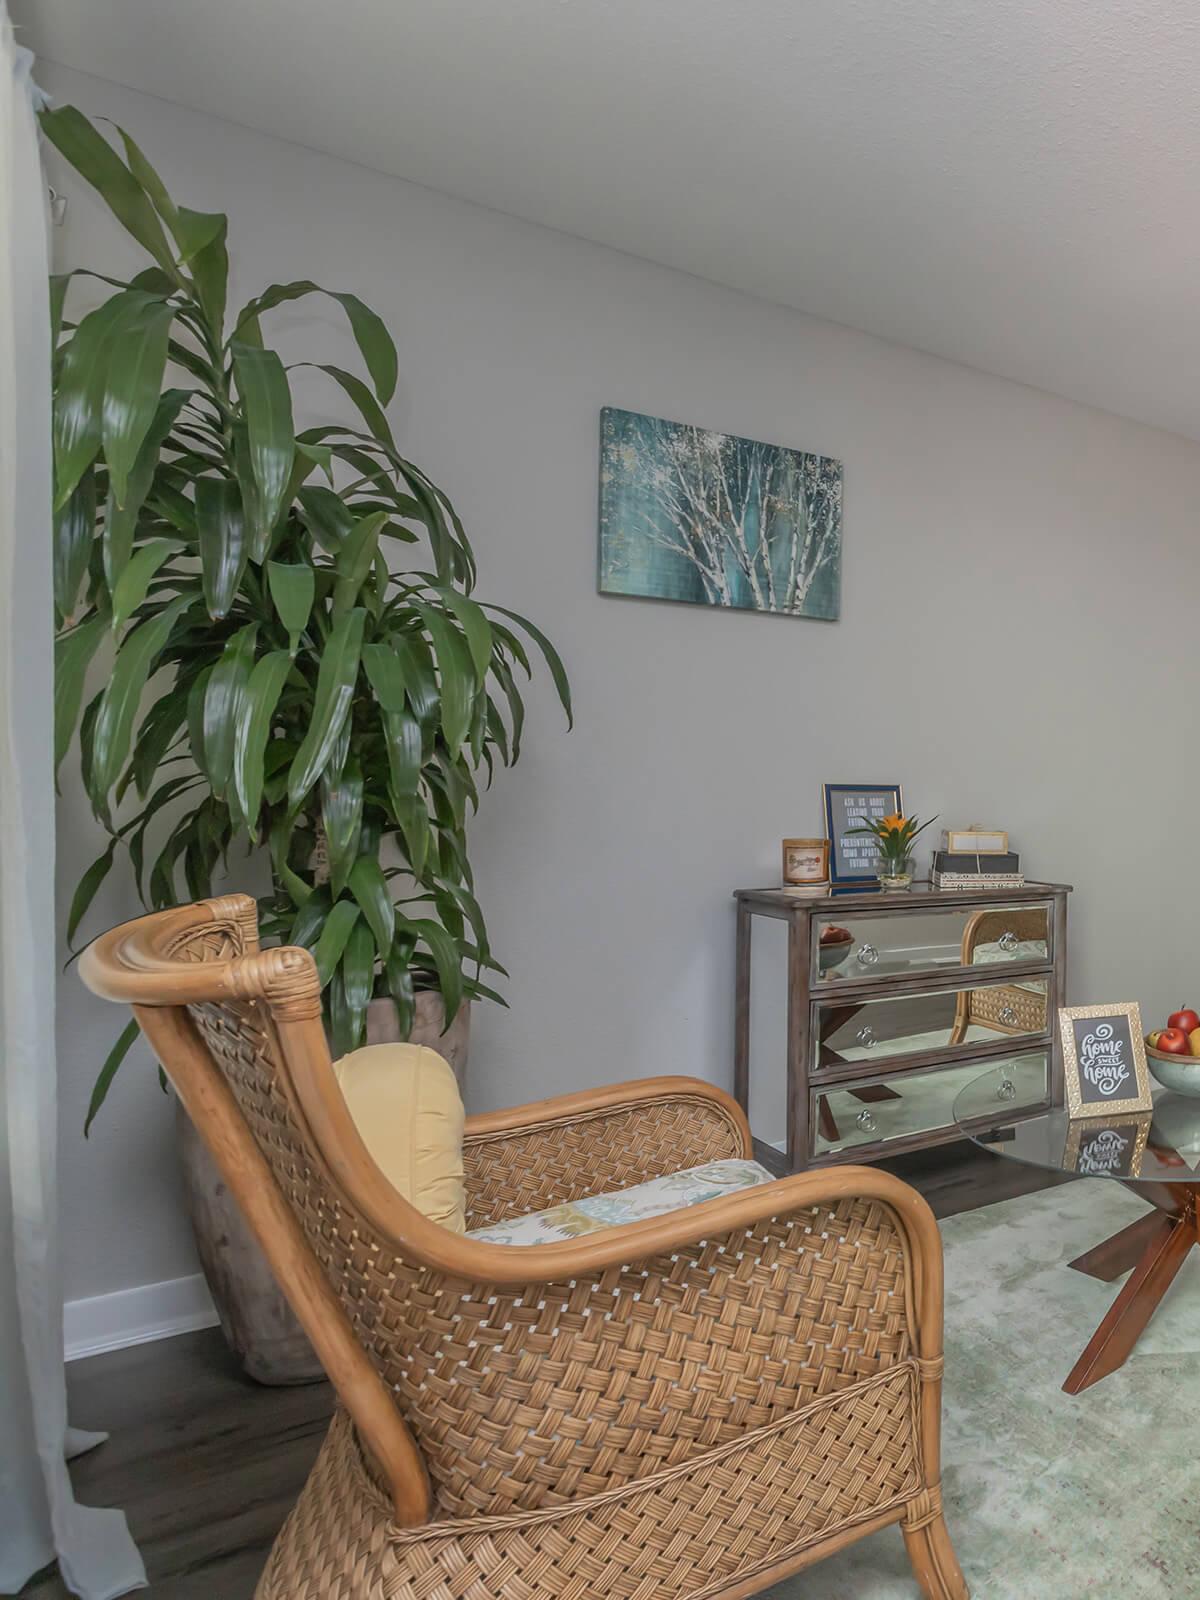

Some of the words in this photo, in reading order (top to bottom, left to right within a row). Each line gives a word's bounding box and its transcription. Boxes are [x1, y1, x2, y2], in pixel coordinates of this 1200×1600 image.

[844, 797, 855, 806] ASK
[858, 798, 866, 806] US
[869, 798, 885, 806] ABOUT
[847, 808, 867, 816] LEASING
[871, 808, 884, 816] YOUR
[1082, 1029, 1123, 1059] home
[1080, 1056, 1130, 1087] home
